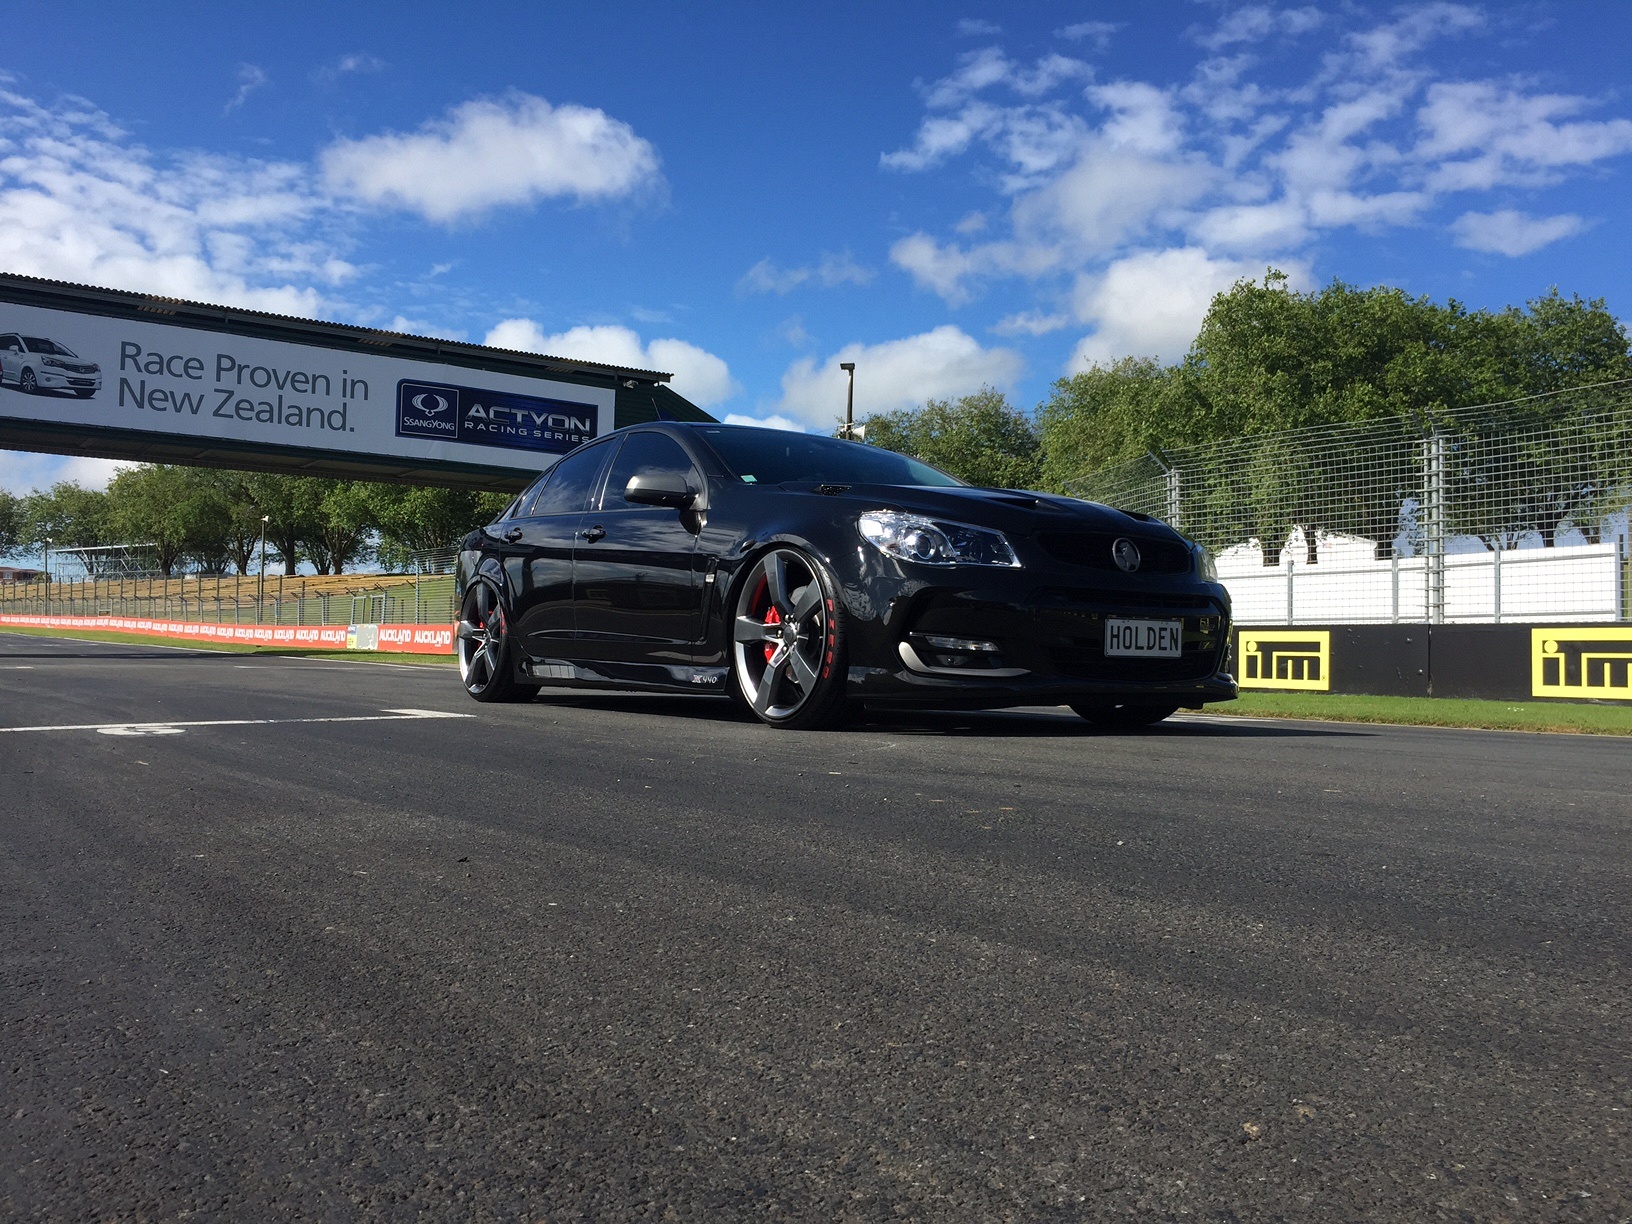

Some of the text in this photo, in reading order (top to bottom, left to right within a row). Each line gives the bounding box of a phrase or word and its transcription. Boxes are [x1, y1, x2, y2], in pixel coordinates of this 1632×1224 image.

[119, 341, 369, 401] Race Proven in
[119, 377, 355, 433] New Zealand.
[465, 403, 591, 434] ACTYON
[464, 421, 591, 444] RACING SERIES
[320, 630, 346, 642] AUCKLAND
[379, 629, 411, 643] AUCKLAND
[414, 630, 451, 645] AUCKLAND
[1110, 625, 1178, 651] HOLDEN
